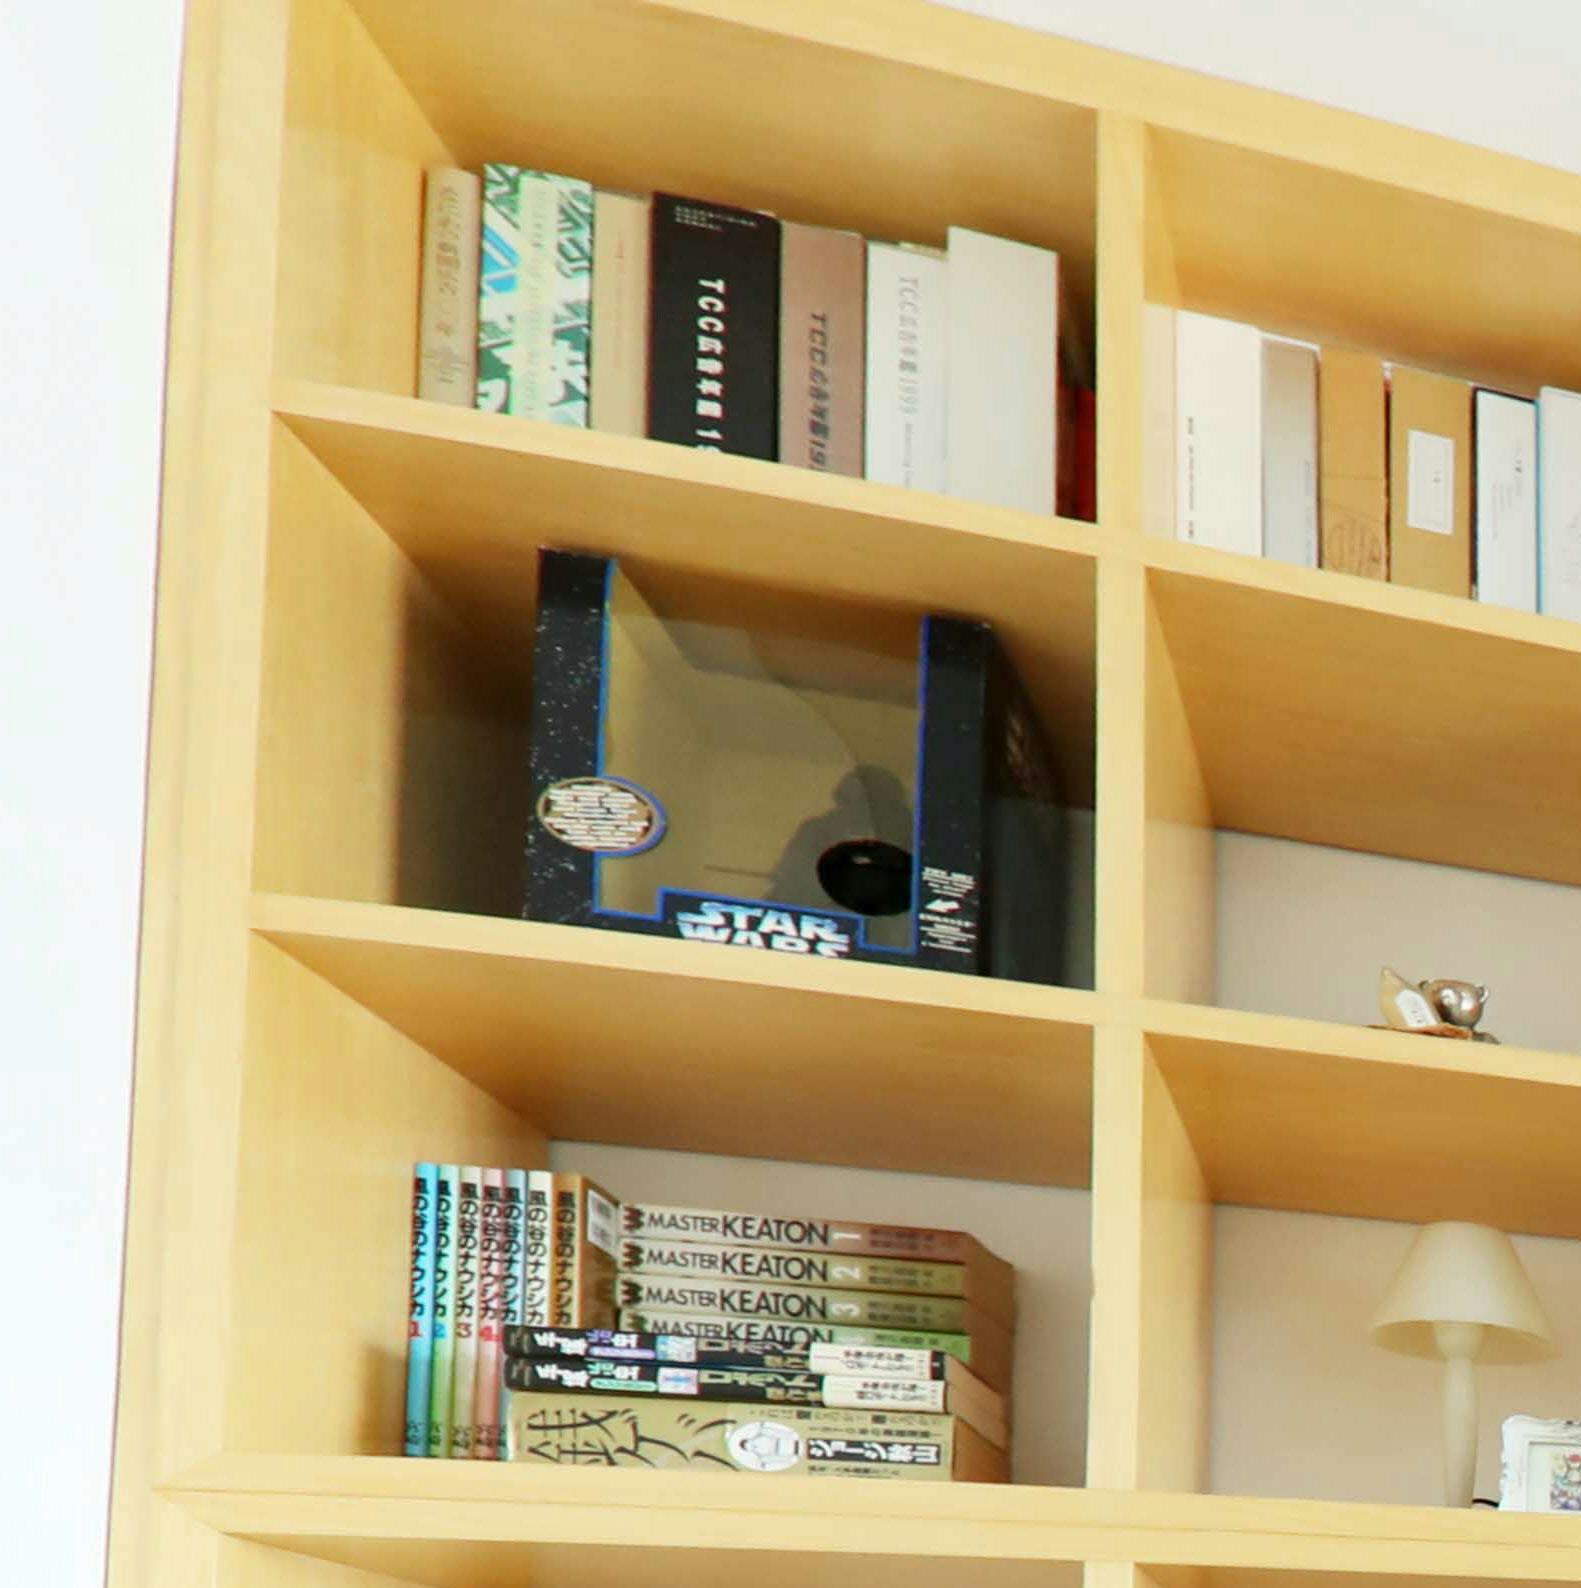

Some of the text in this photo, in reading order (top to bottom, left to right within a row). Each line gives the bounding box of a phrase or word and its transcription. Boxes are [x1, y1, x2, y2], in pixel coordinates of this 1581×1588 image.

[676, 901, 850, 943] STAR
[648, 1212, 721, 1234] MASTER
[721, 1214, 830, 1247] KEATON
[527, 1189, 548, 1325] 風の谷のナウシカ
[645, 1249, 720, 1271] MASTER
[719, 1250, 829, 1282] KEATON
[645, 1287, 719, 1308] MASTER
[718, 1288, 828, 1320] KEATON
[456, 1323, 472, 1338] 3
[651, 1319, 725, 1340] MASTER
